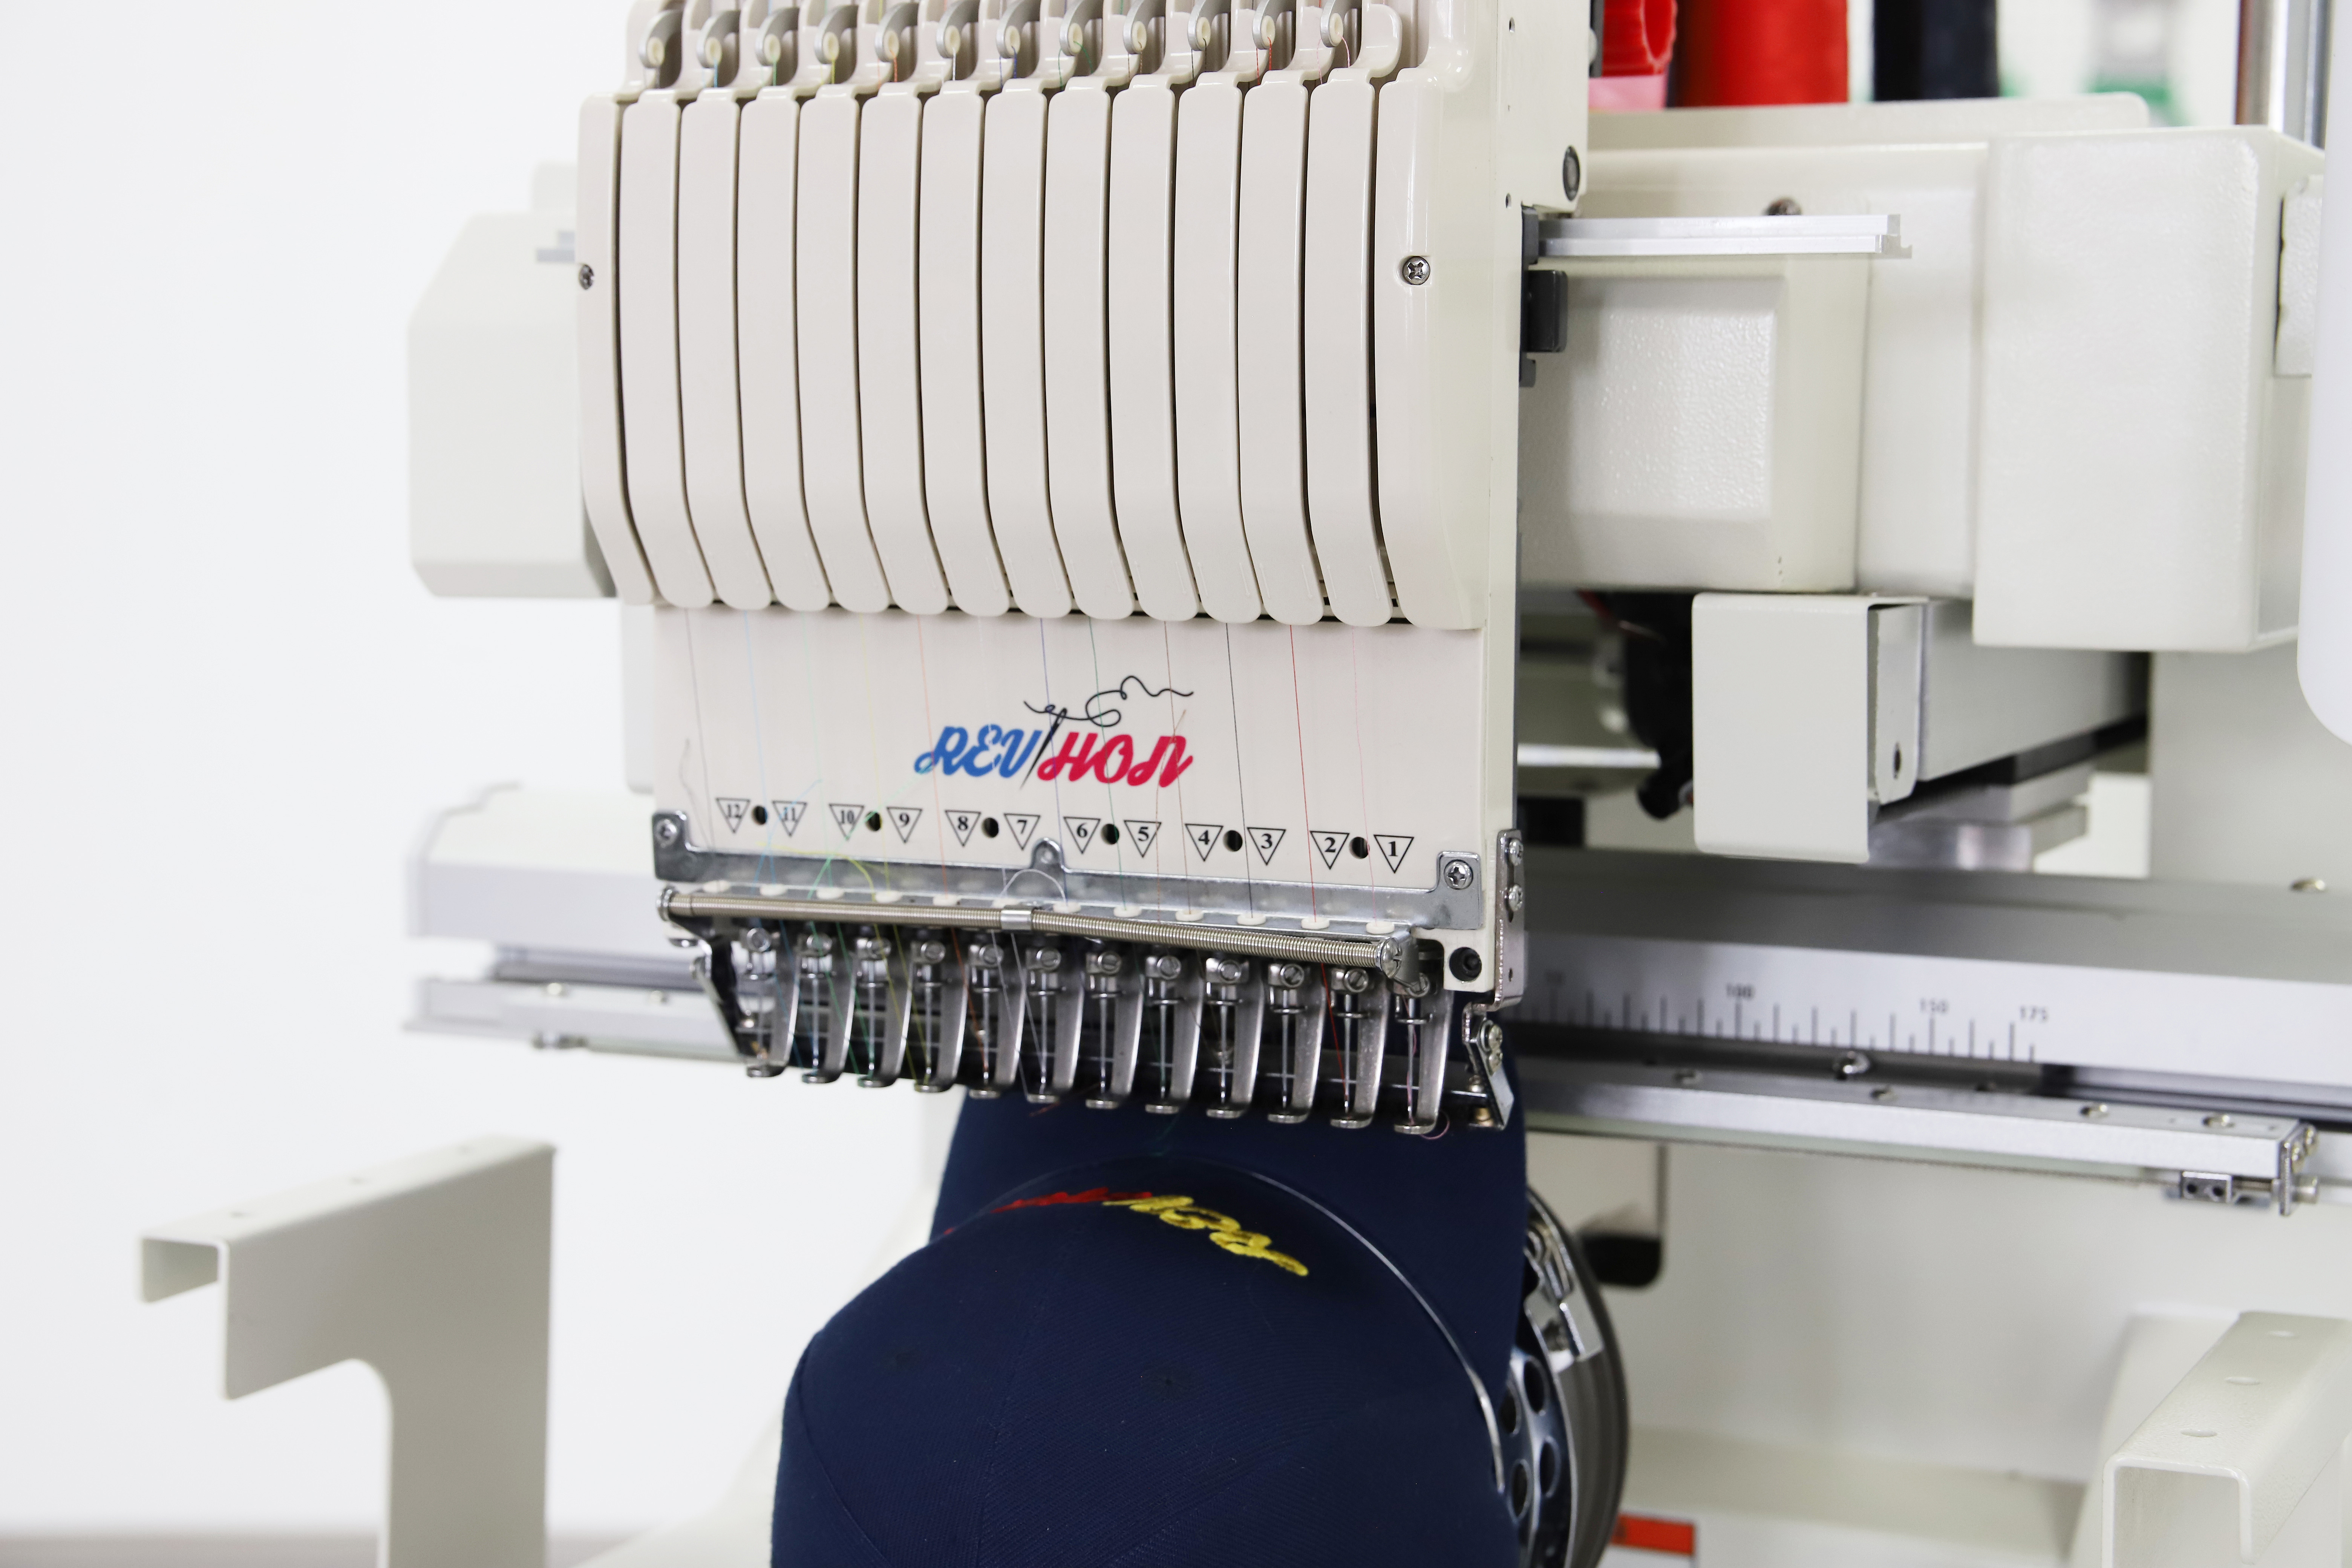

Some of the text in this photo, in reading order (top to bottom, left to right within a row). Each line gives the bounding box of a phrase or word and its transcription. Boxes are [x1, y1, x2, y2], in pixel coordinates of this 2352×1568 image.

[727, 804, 1399, 857] 12 11 10 9 8 7 6 5 4 3 2 1
[1920, 997, 1949, 1015] 150
[2020, 1005, 2048, 1023] 175
